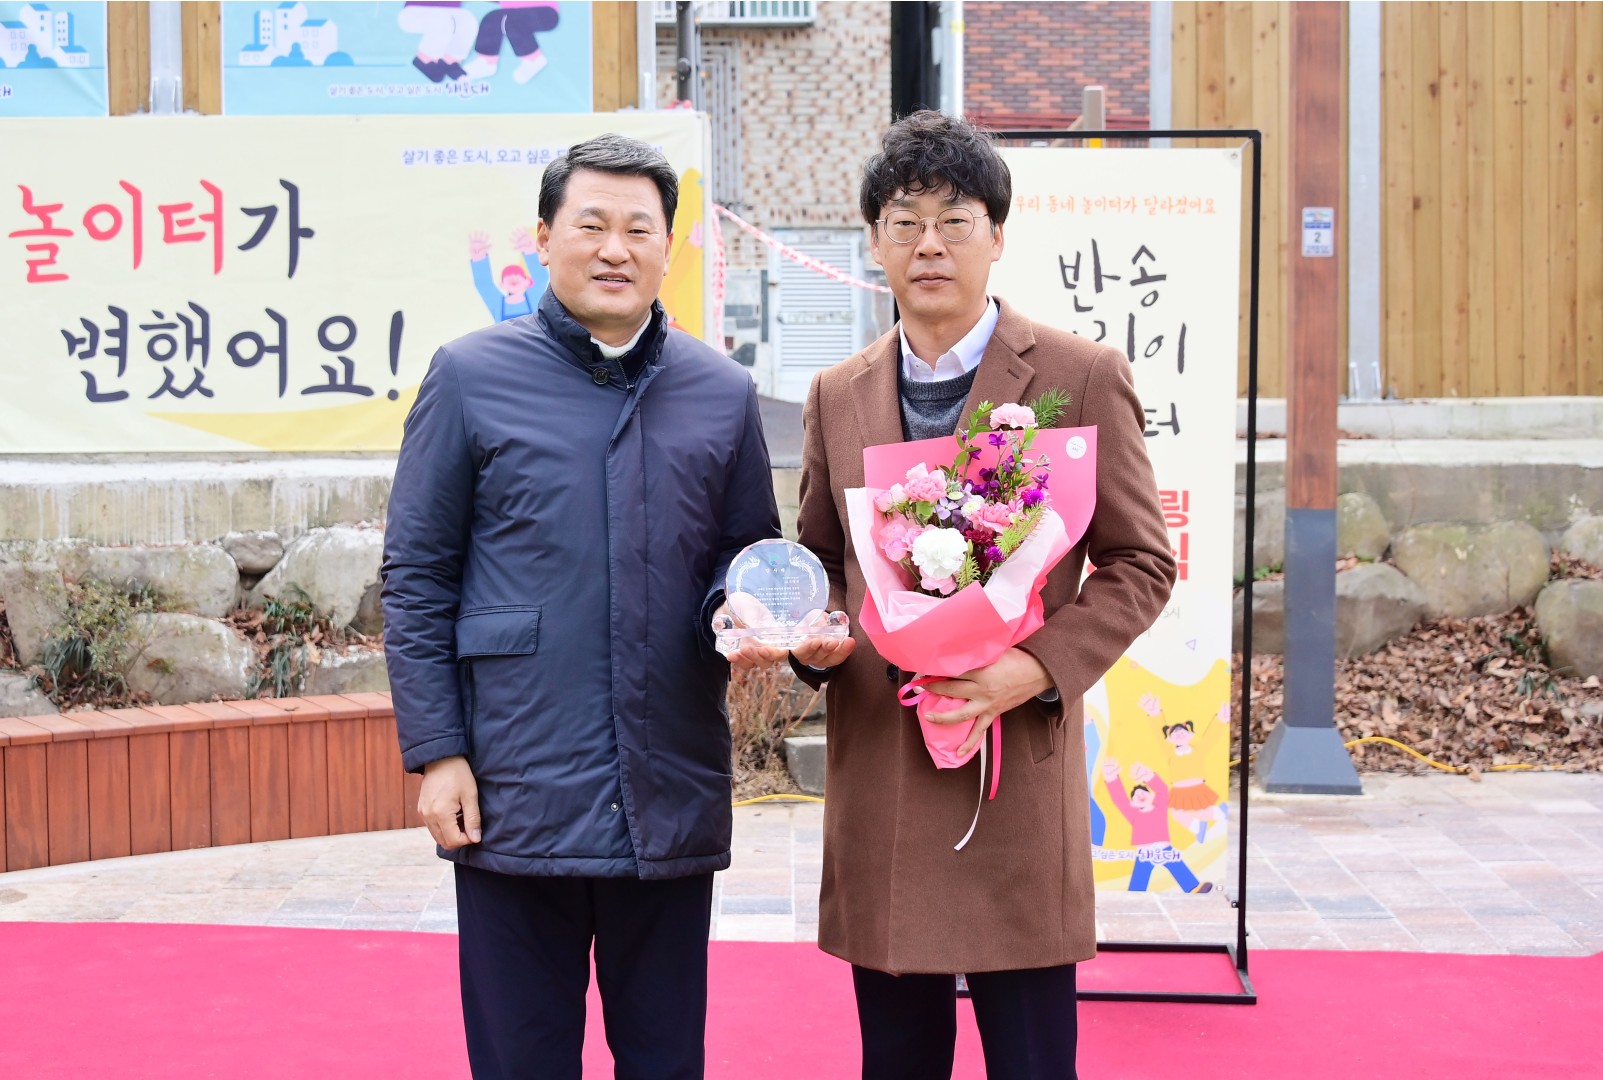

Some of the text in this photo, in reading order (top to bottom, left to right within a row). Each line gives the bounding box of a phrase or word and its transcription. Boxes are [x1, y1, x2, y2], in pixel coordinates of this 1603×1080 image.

[403, 149, 429, 165] 살기
[433, 149, 459, 165] 좋은
[463, 150, 493, 165] 도시,
[496, 150, 521, 163] 오고
[526, 149, 551, 165] 싶은
[1015, 195, 1217, 216] 우리 동네 놀이터가 달라졌어요
[8, 178, 315, 283] 놀이터가
[1314, 232, 1321, 243] 2
[1058, 238, 1167, 313] 반송
[60, 300, 404, 403] 변했어요!
[1072, 312, 1187, 374] 리이
[1138, 848, 1181, 865] 해운대
